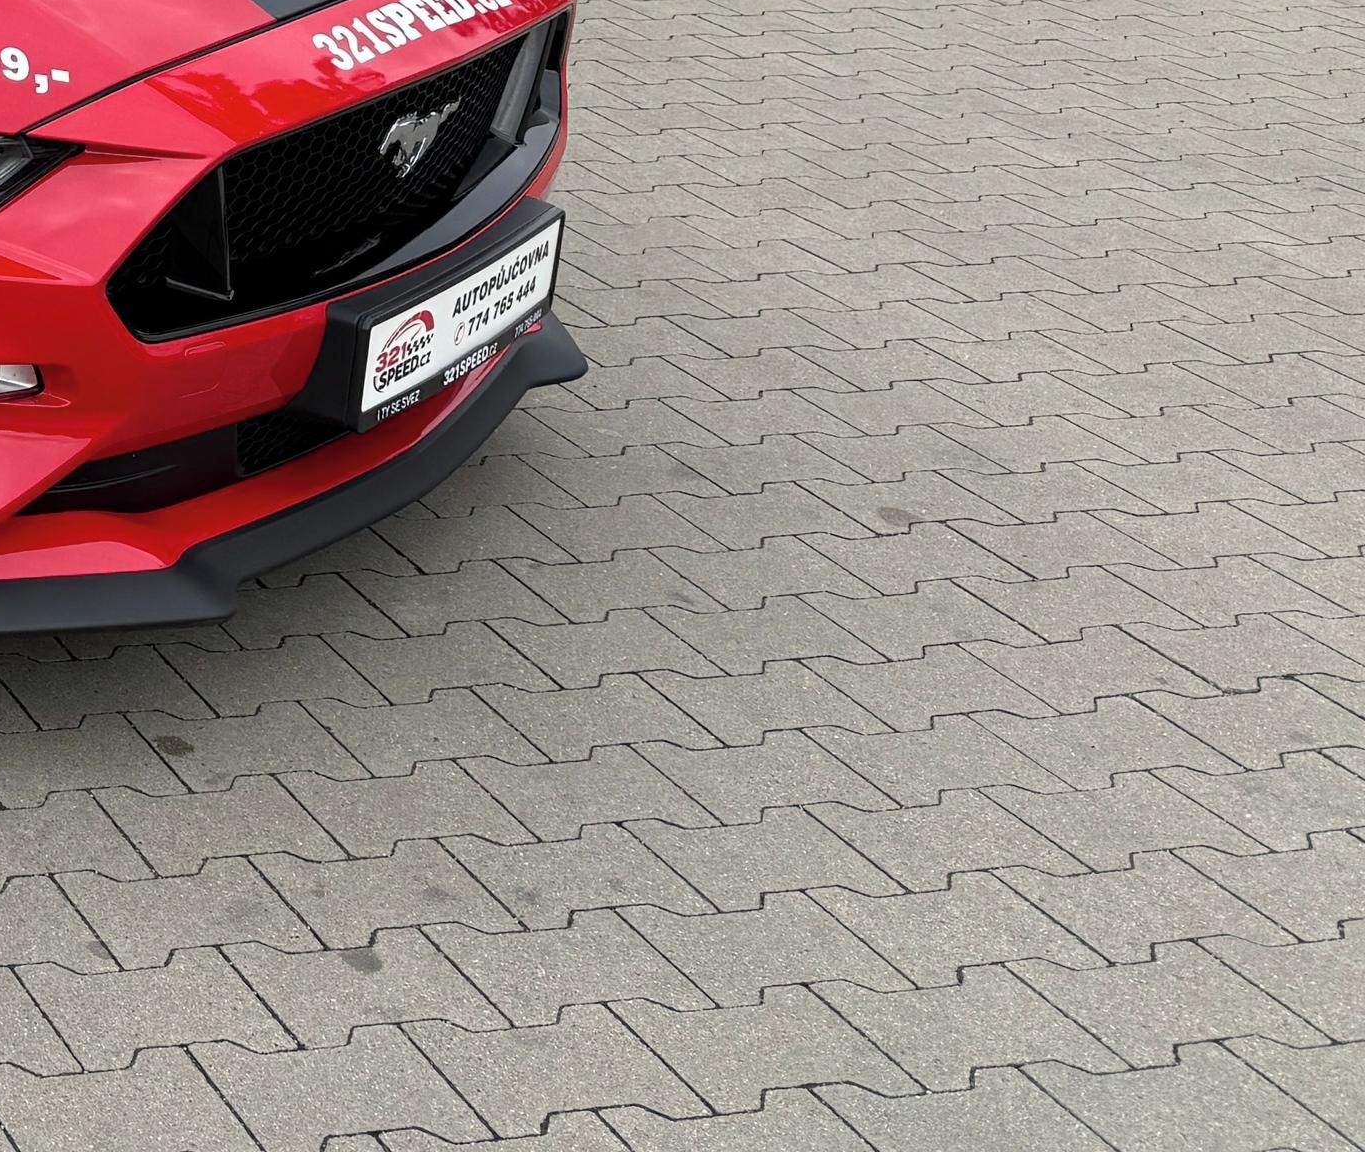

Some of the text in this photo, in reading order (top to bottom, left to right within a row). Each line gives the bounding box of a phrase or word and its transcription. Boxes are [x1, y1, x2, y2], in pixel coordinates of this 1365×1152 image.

[468, 275, 537, 337] 774 765 444
[375, 341, 408, 374] 321
